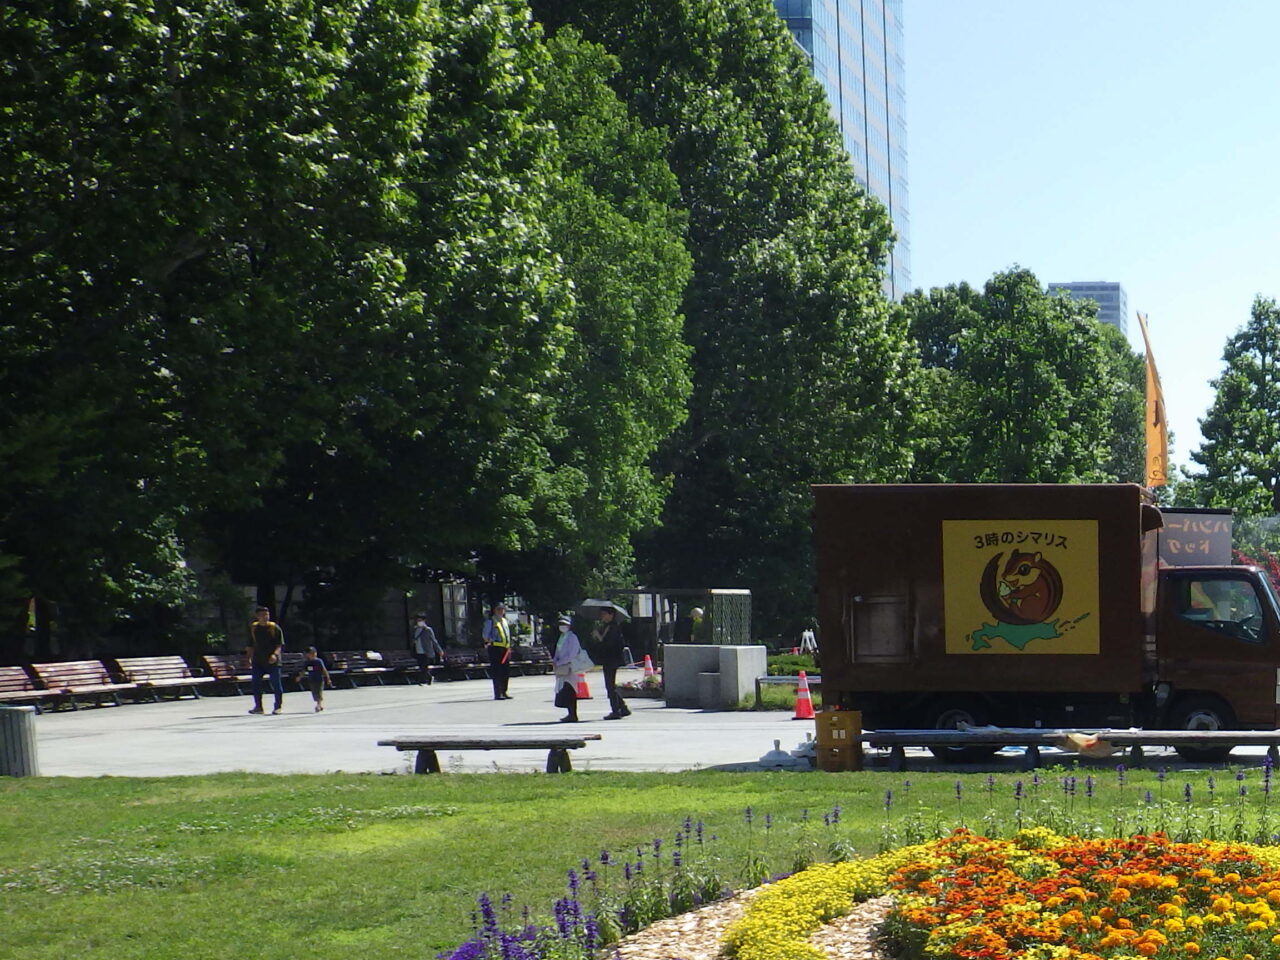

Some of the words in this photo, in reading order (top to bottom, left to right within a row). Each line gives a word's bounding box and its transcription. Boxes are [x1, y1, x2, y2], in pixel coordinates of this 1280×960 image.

[974, 531, 1068, 549] 3時のシマリス
